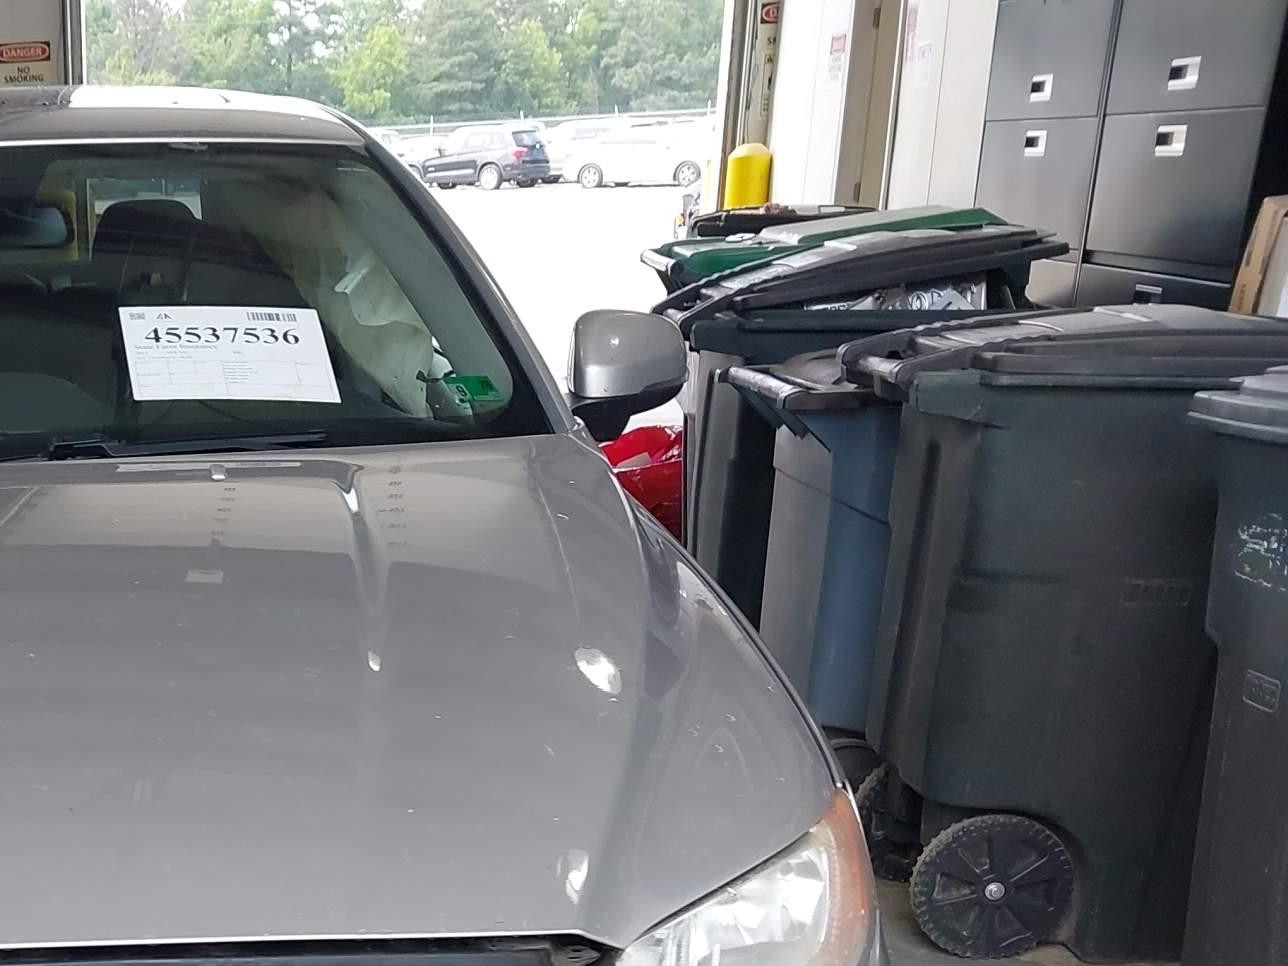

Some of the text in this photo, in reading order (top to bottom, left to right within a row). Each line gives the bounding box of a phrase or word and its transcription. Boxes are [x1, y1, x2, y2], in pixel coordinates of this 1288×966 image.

[2, 47, 43, 58] DANGER
[16, 65, 31, 74] NO
[3, 74, 45, 83] SMOKING
[144, 327, 300, 346] 45537536
